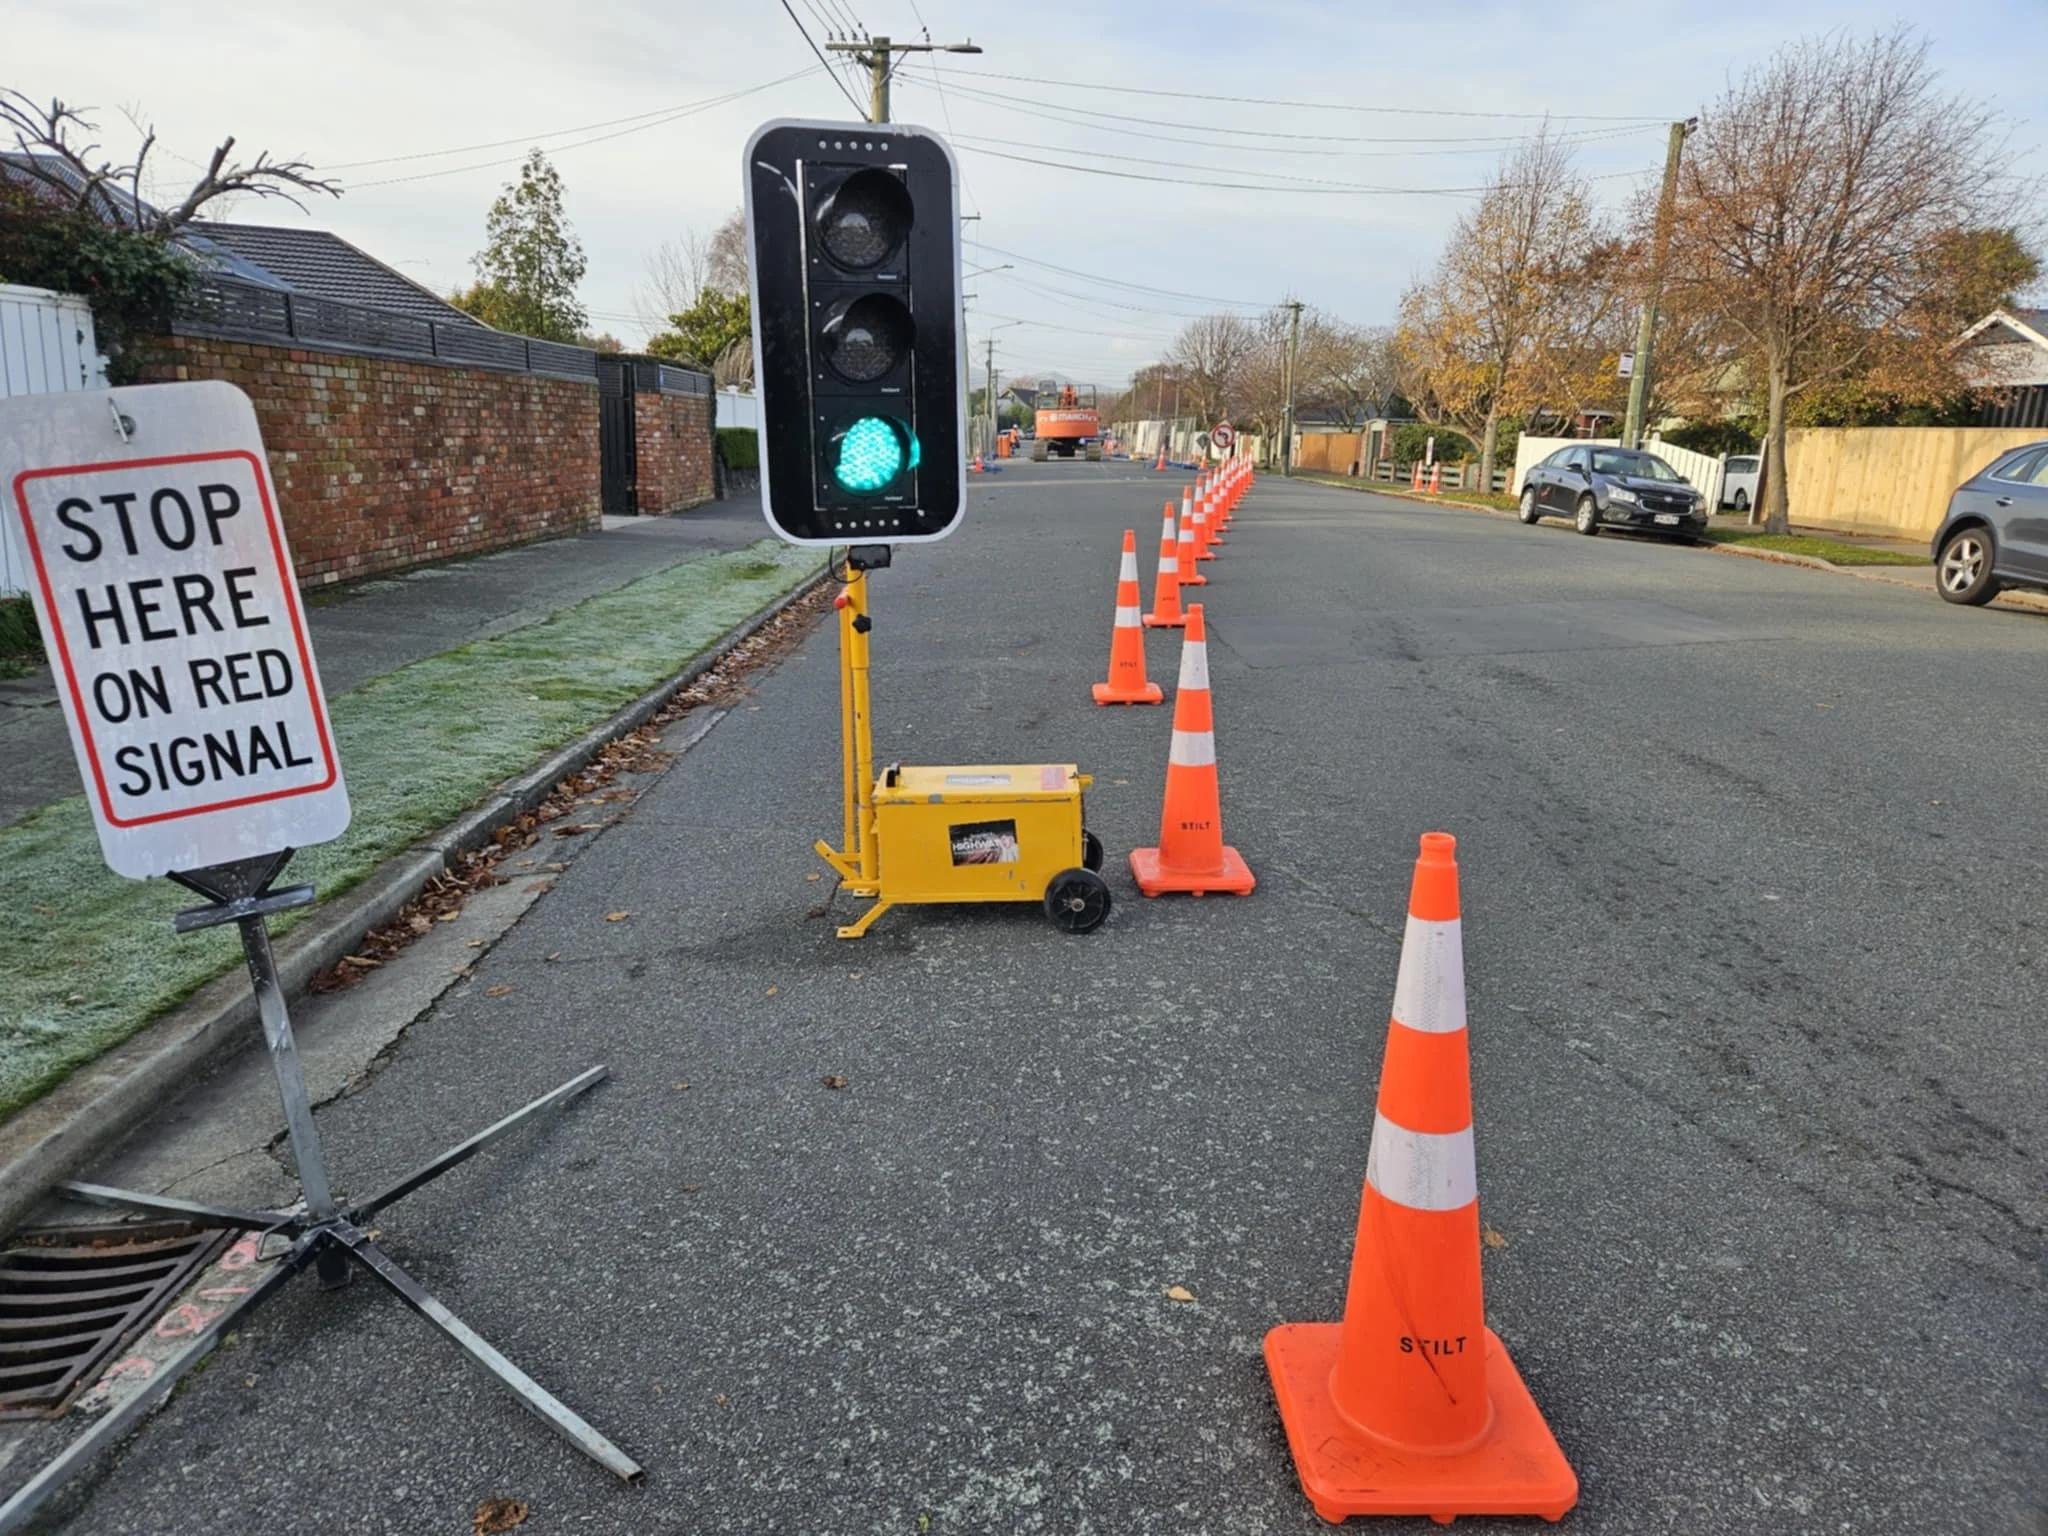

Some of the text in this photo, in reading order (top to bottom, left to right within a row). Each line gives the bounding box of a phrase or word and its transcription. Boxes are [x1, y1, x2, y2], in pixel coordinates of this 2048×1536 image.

[56, 483, 241, 563] STOP
[75, 566, 270, 649] HERE
[93, 648, 293, 724] ON RED
[115, 720, 313, 797] SIGNAL
[1181, 821, 1211, 830] STILT
[1399, 1336, 1467, 1356] STILT
